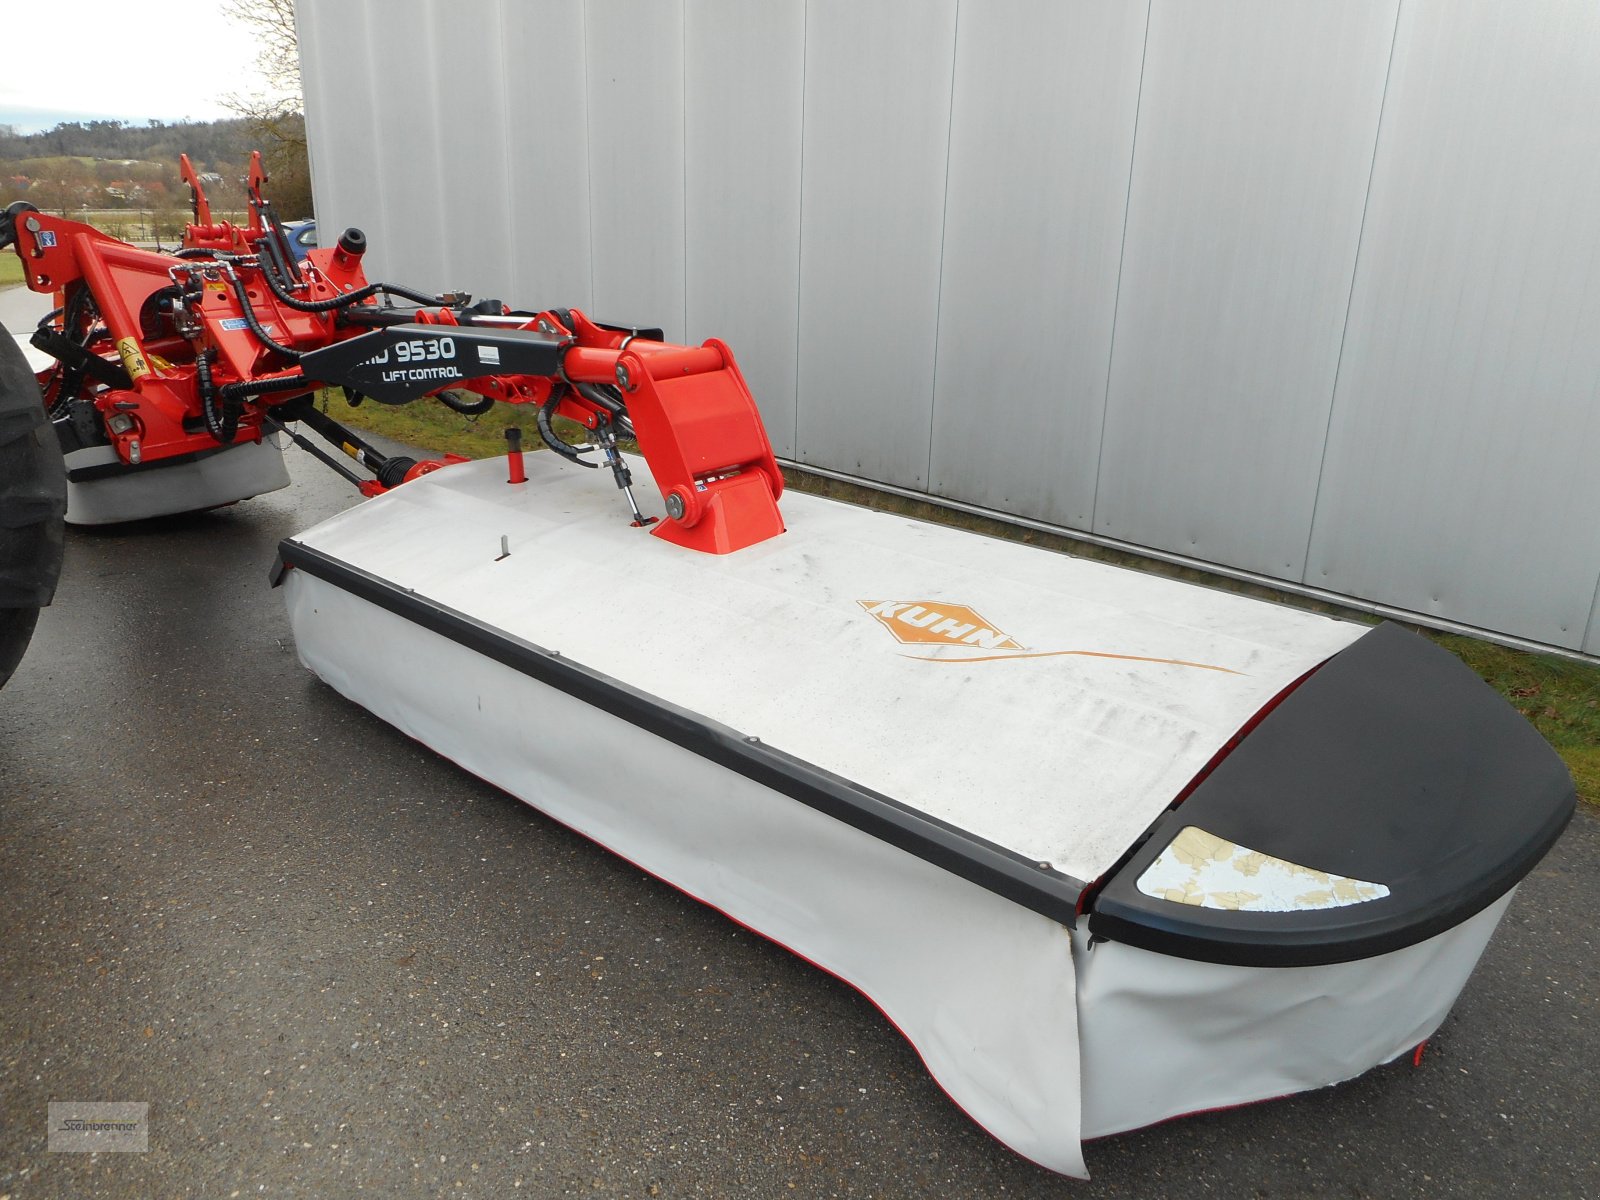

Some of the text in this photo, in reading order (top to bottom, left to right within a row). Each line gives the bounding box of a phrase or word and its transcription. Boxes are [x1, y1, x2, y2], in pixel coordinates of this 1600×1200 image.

[395, 337, 456, 363] 9530
[382, 366, 463, 382] LIFT CONTROL
[864, 600, 1013, 650] KUHN
